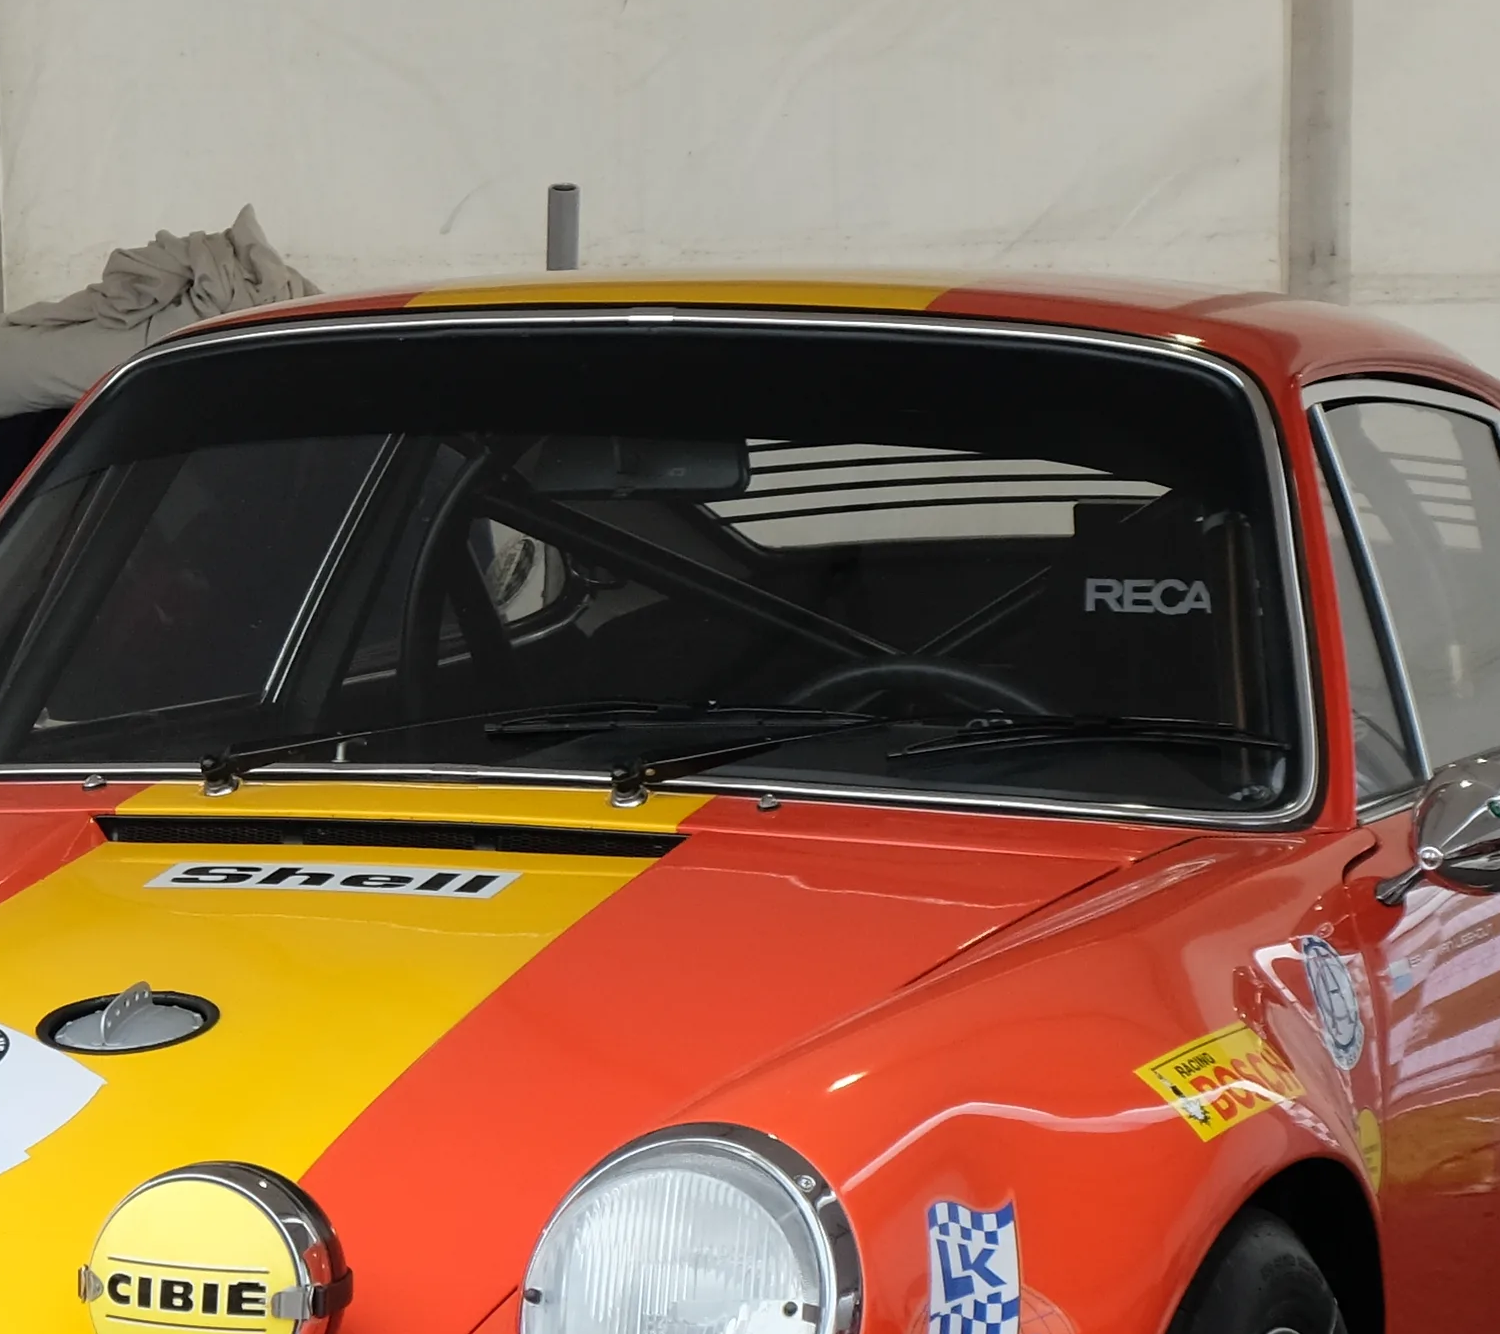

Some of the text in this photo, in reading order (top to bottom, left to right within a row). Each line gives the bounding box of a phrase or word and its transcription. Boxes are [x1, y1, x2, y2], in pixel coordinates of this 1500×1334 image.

[170, 865, 501, 894] Shell
[1174, 1052, 1217, 1079] RACING
[1189, 1046, 1301, 1121] BOSCH
[935, 1237, 1008, 1304] LK
